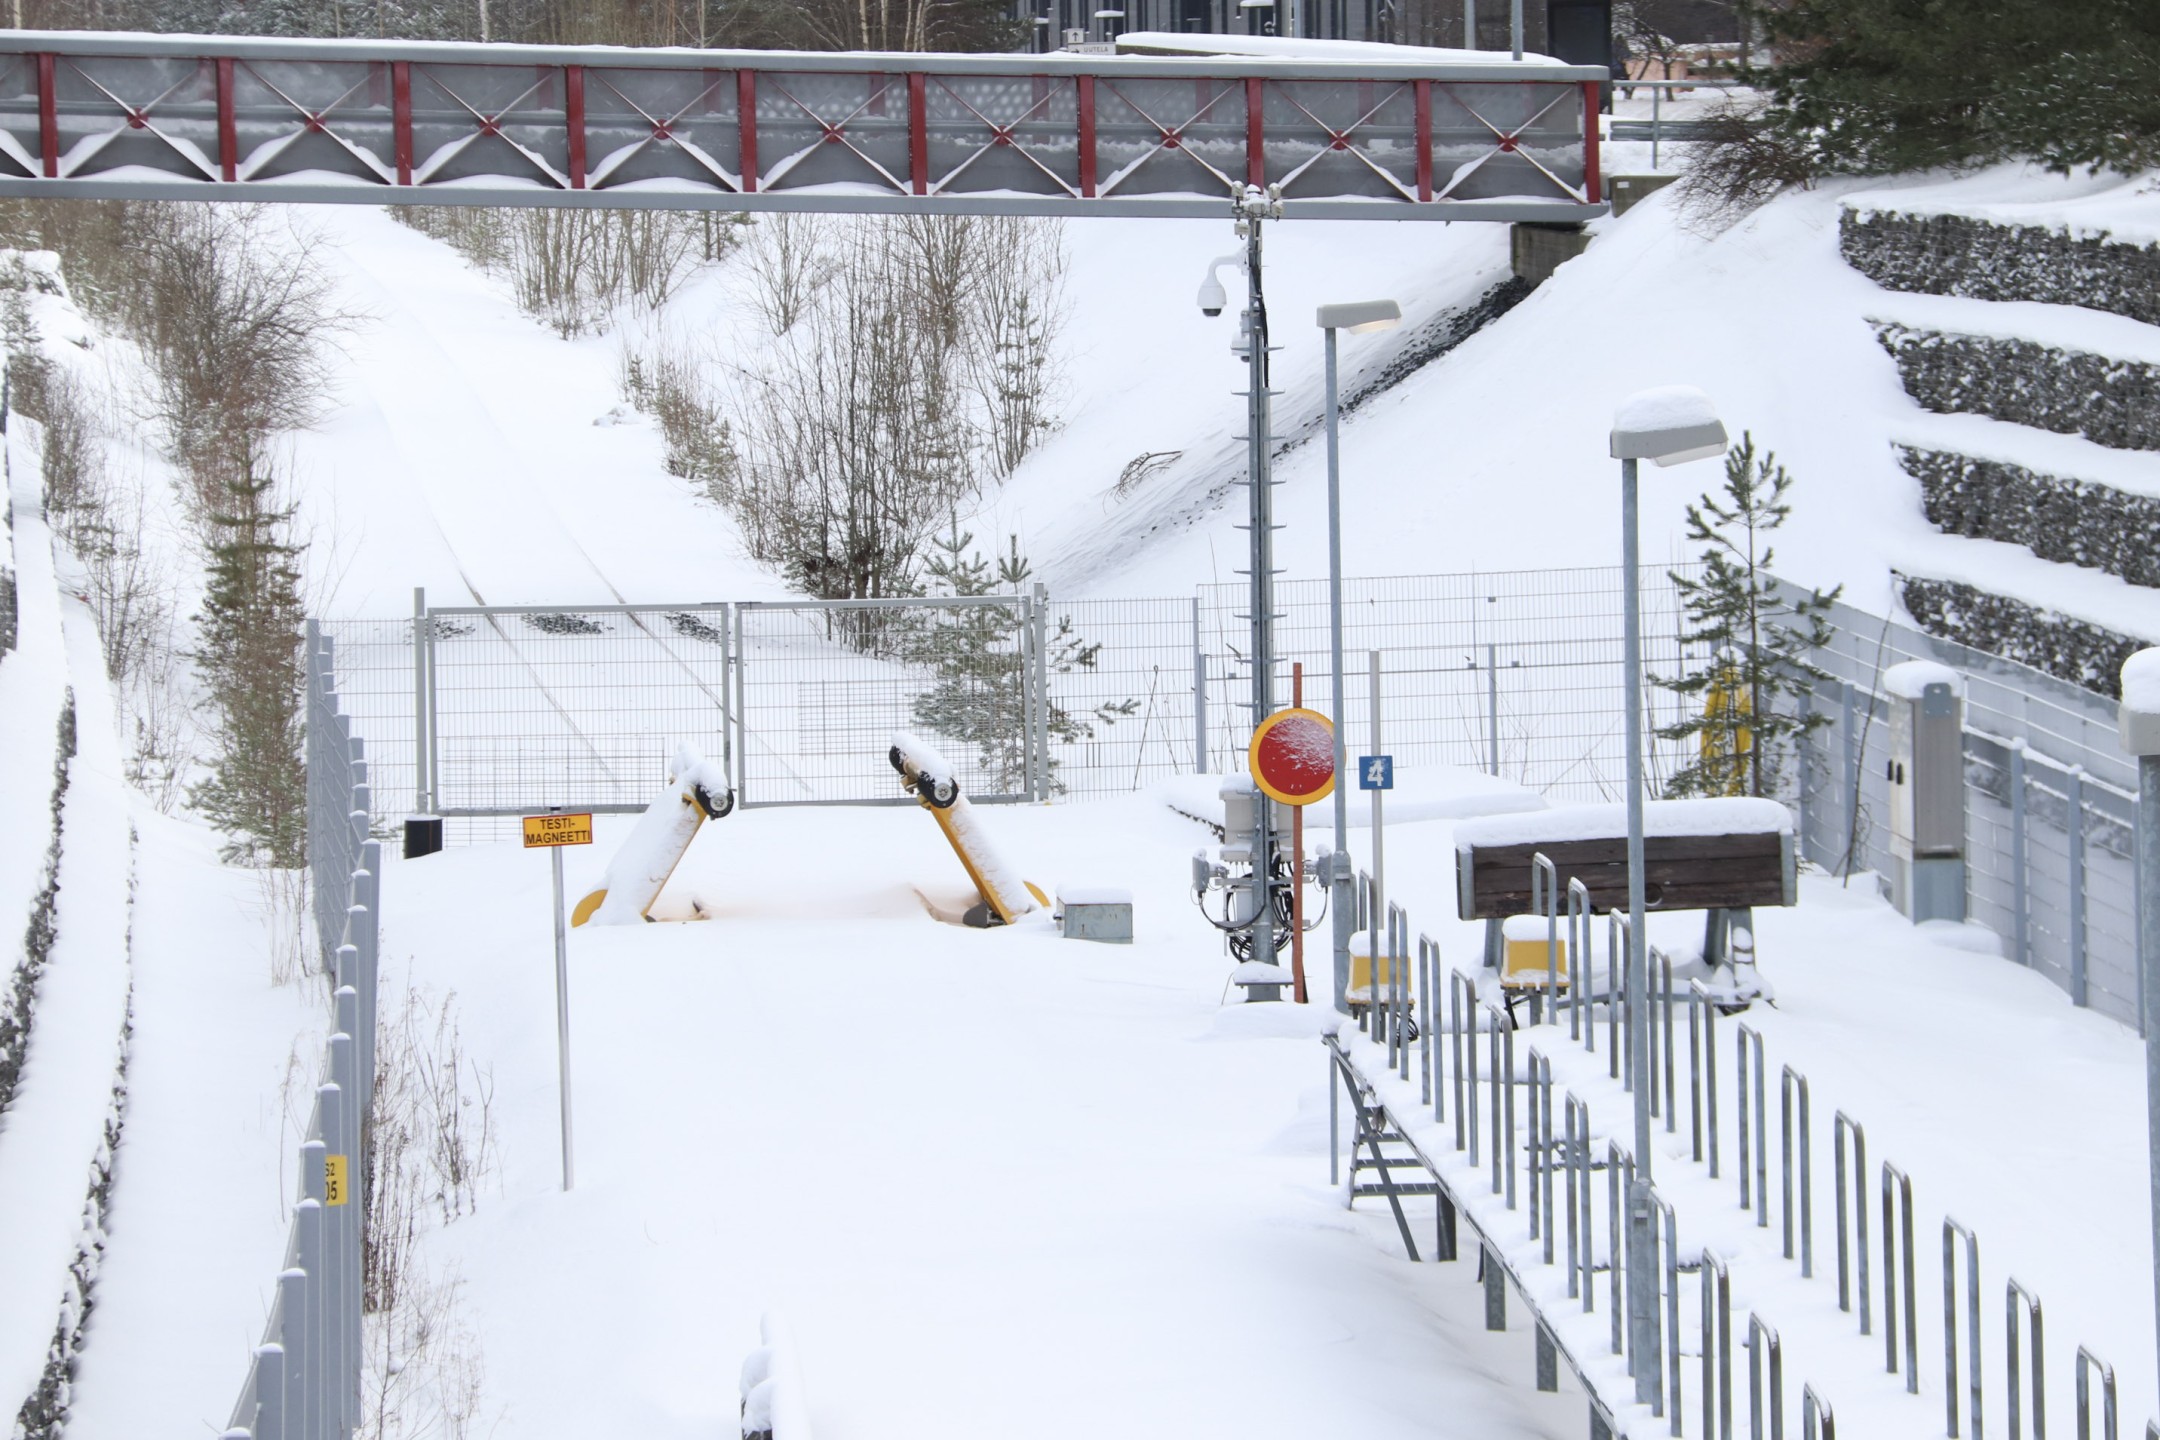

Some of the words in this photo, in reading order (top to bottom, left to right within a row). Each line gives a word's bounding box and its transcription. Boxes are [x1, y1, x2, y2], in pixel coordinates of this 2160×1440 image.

[1367, 759, 1384, 787] 4
[540, 818, 576, 830] TESTI-
[526, 830, 590, 844] MAGNEETTI
